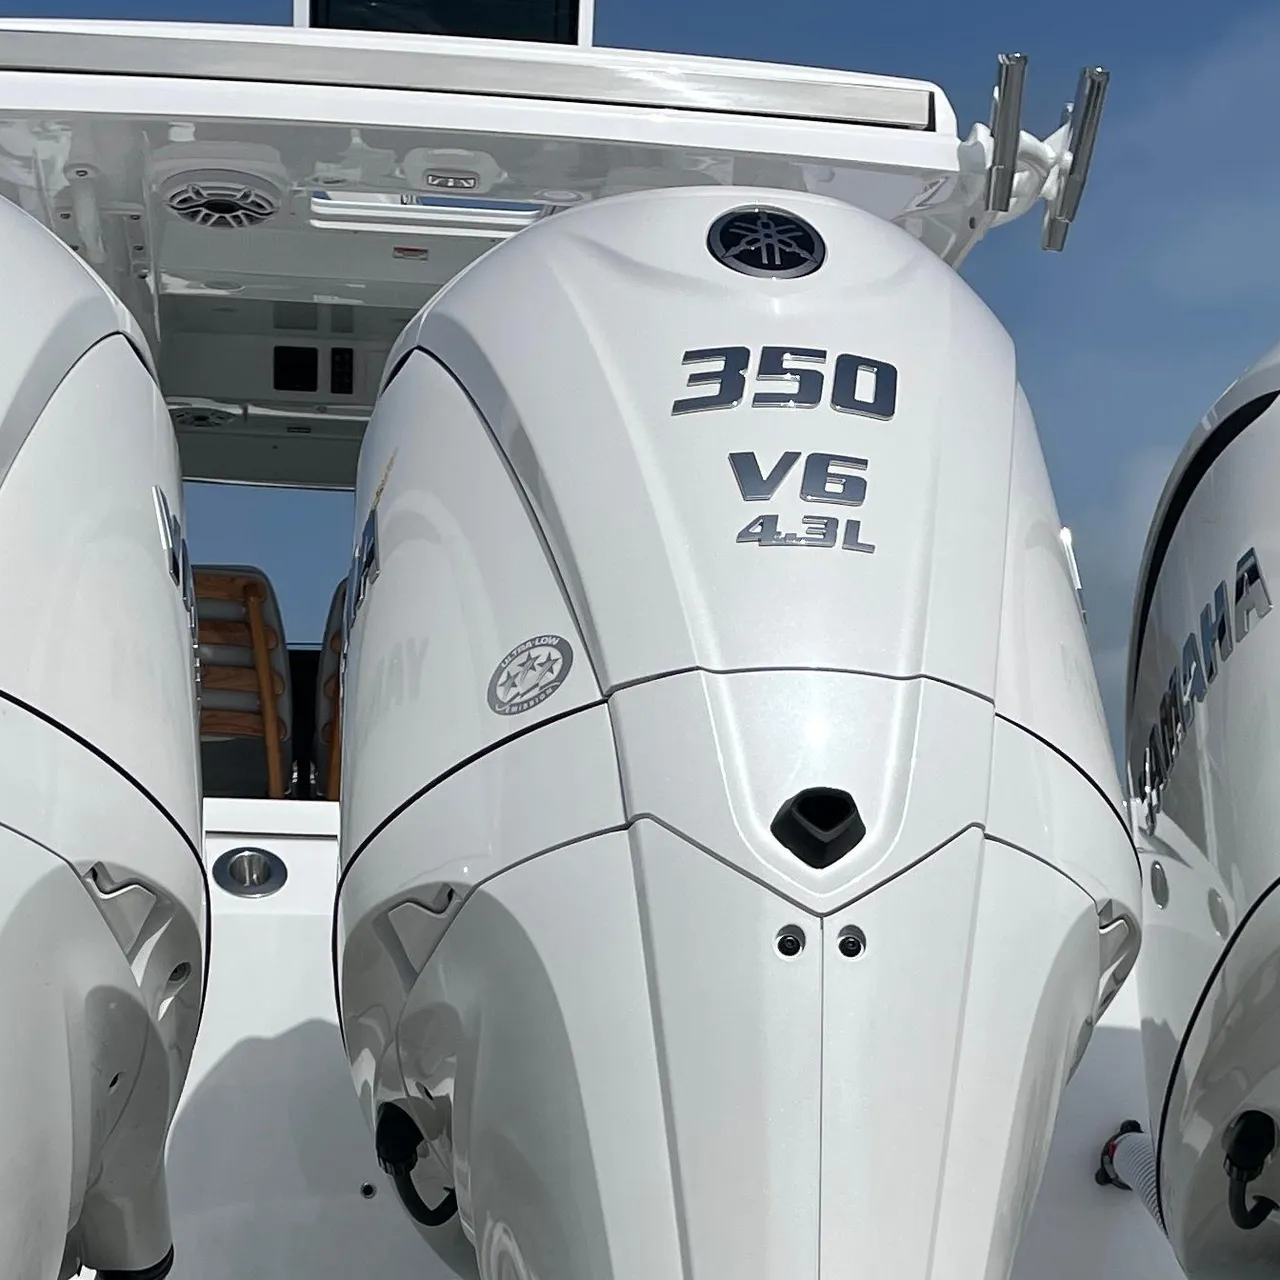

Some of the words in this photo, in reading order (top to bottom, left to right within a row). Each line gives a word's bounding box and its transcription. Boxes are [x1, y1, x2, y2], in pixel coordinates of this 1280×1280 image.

[671, 346, 897, 421] 350
[728, 451, 868, 507] V6
[736, 514, 875, 555] 4.3L
